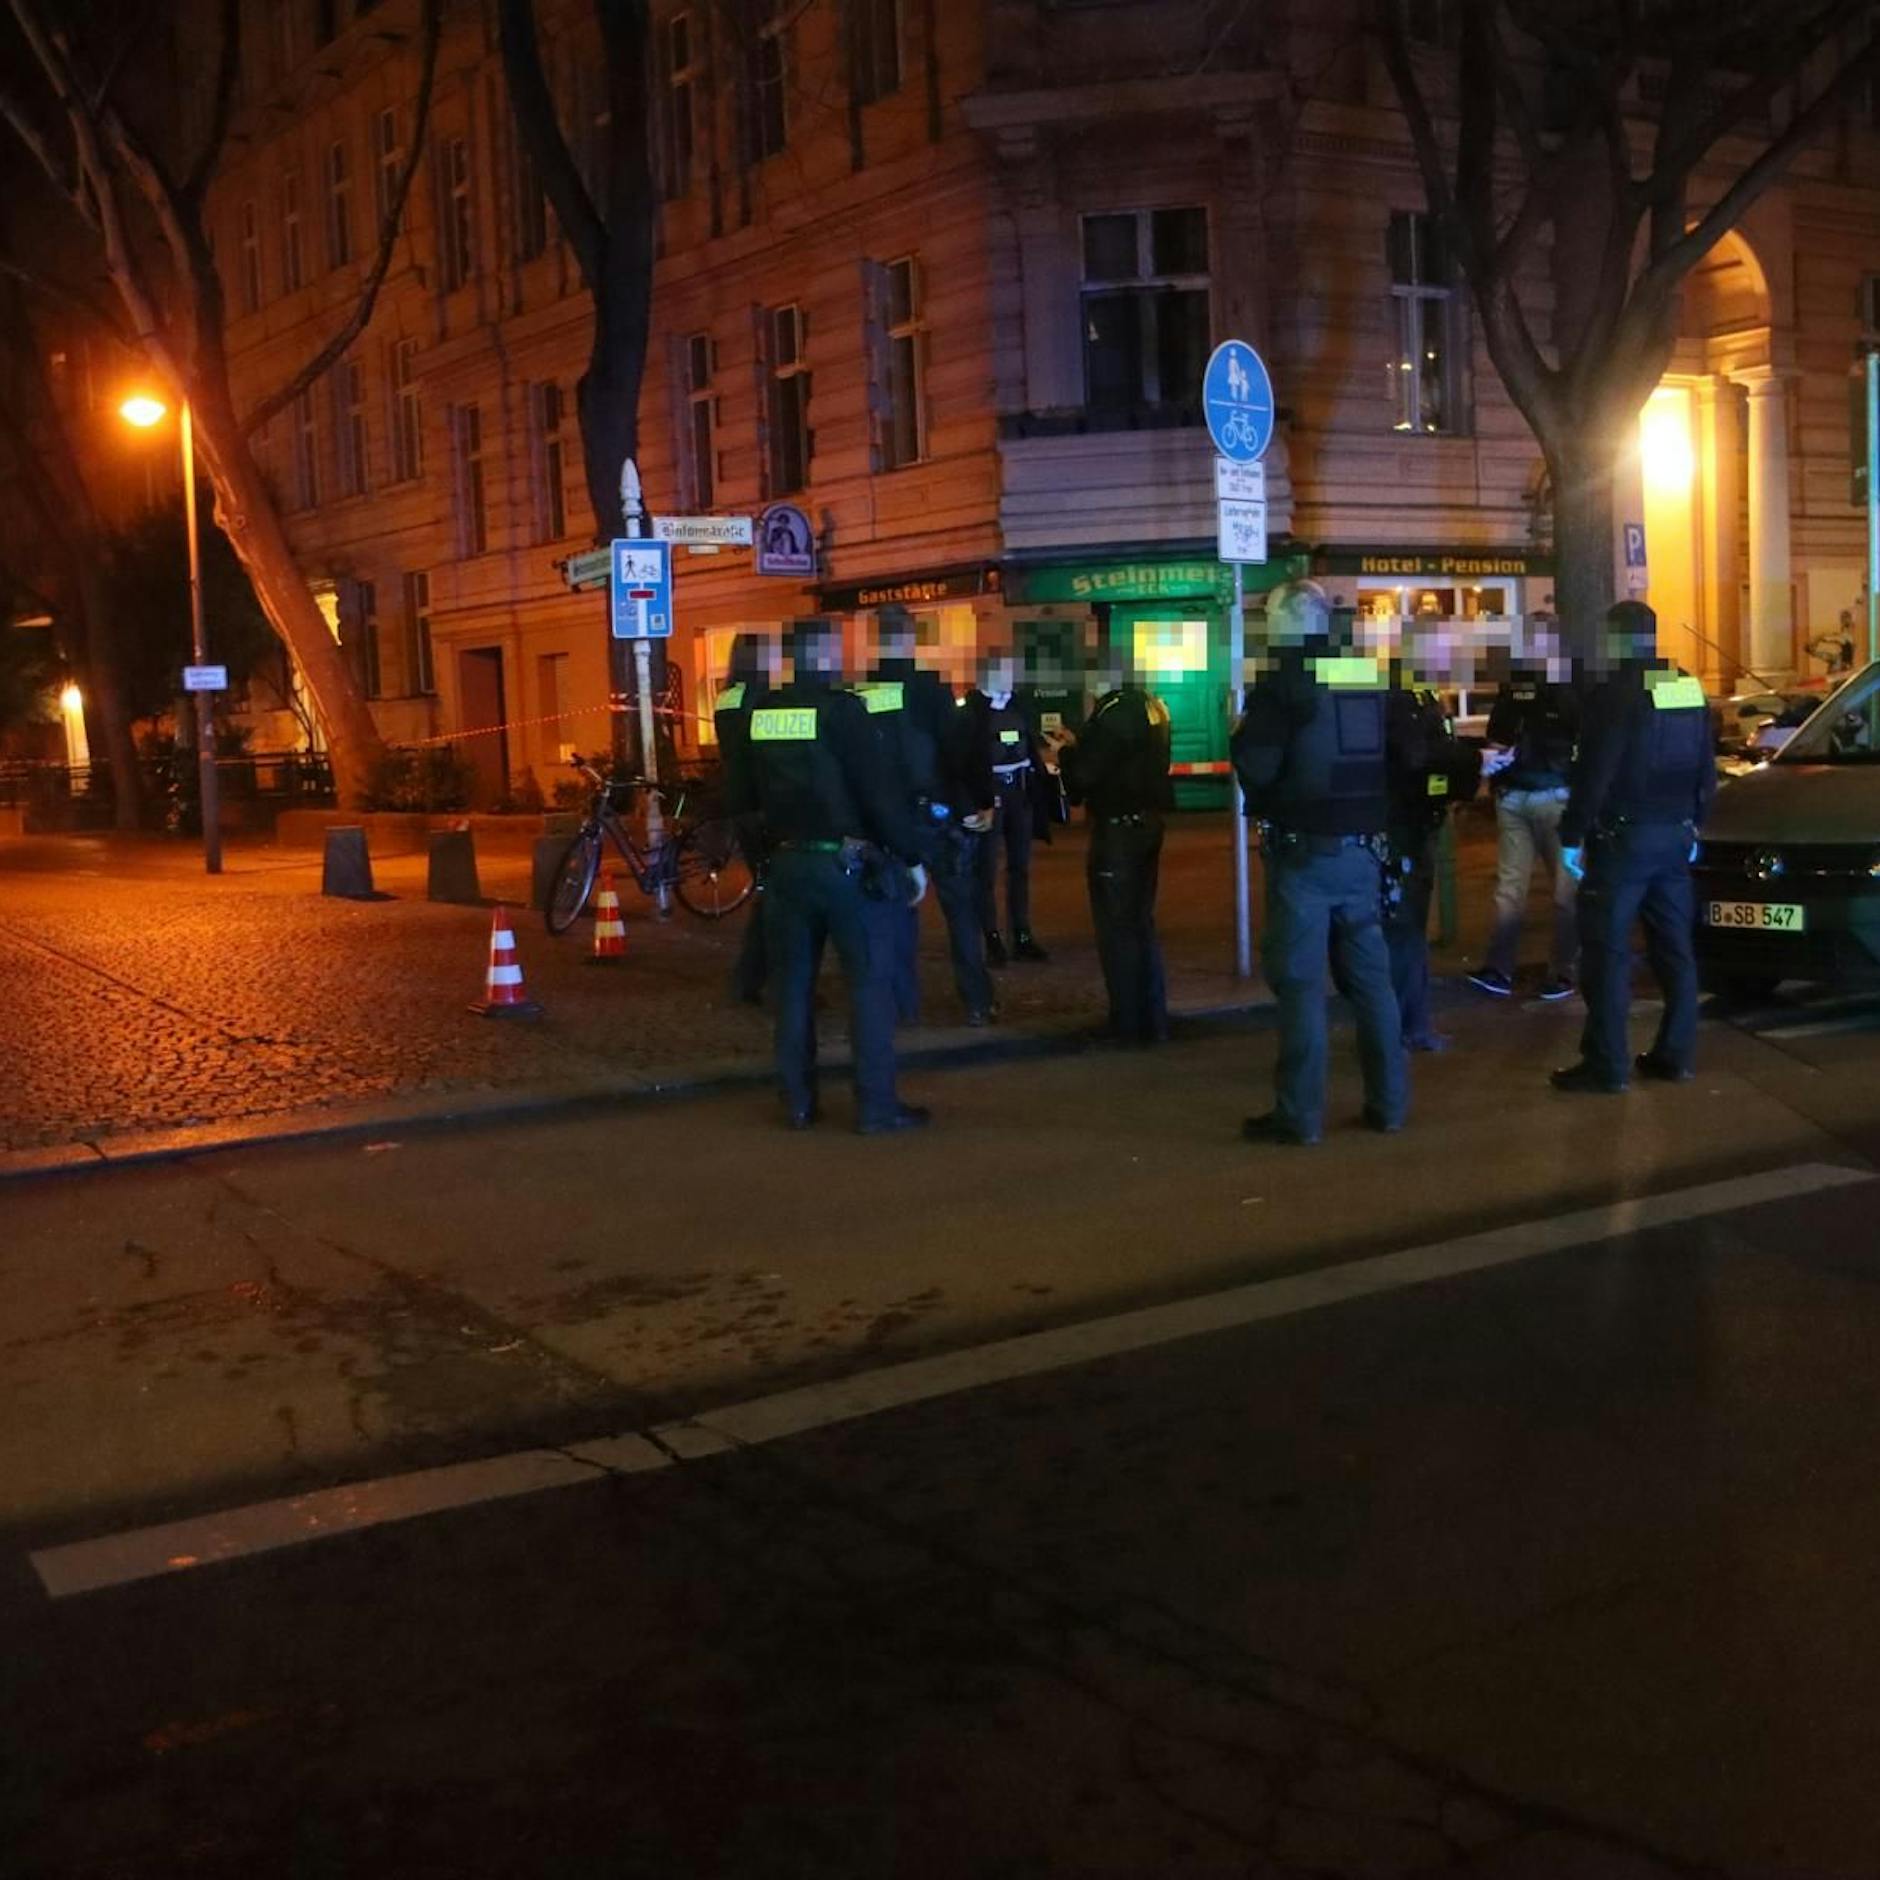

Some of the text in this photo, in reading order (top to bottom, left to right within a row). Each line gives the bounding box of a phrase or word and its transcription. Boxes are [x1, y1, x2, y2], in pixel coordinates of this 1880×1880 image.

[1361, 556, 1422, 573] Hotel
[1441, 557, 1526, 574] Pension
[858, 582, 947, 604] Gaststätte
[754, 713, 814, 735] POLIZEI
[1712, 904, 1795, 927] B SB 547
